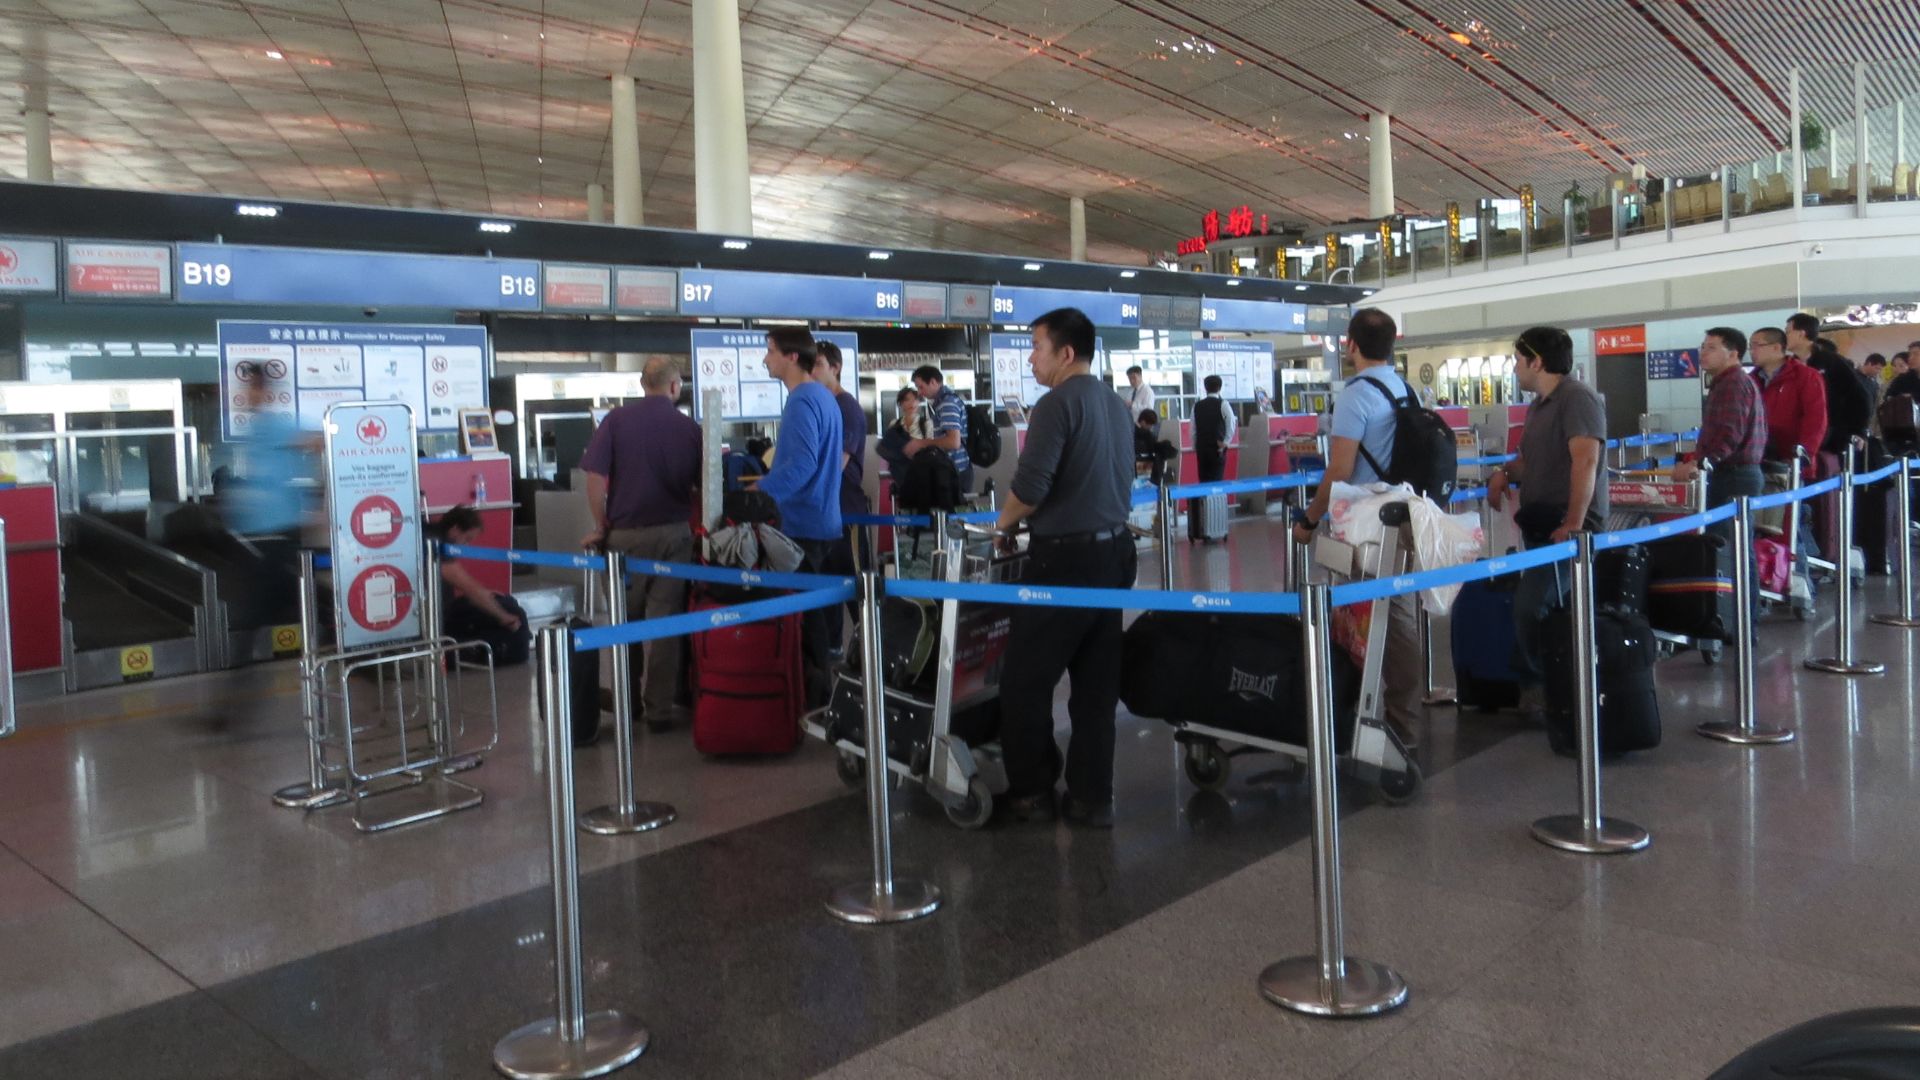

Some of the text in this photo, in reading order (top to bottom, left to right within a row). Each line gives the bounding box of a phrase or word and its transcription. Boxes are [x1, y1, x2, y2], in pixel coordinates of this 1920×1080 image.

[183, 261, 231, 287] B19
[501, 275, 536, 296] B18
[684, 283, 713, 302] B17
[876, 292, 900, 309] B16
[994, 298, 1014, 313] B15
[1122, 303, 1138, 318] B14
[1202, 308, 1216, 322] B13
[1293, 312, 1306, 325] B12
[344, 332, 377, 341] Reminder
[339, 446, 407, 457] AIR CANADA
[1032, 591, 1052, 600] BCIA
[1208, 597, 1231, 606] BCIA
[723, 612, 741, 622] BCIA
[1228, 667, 1278, 699] EVERLAST
